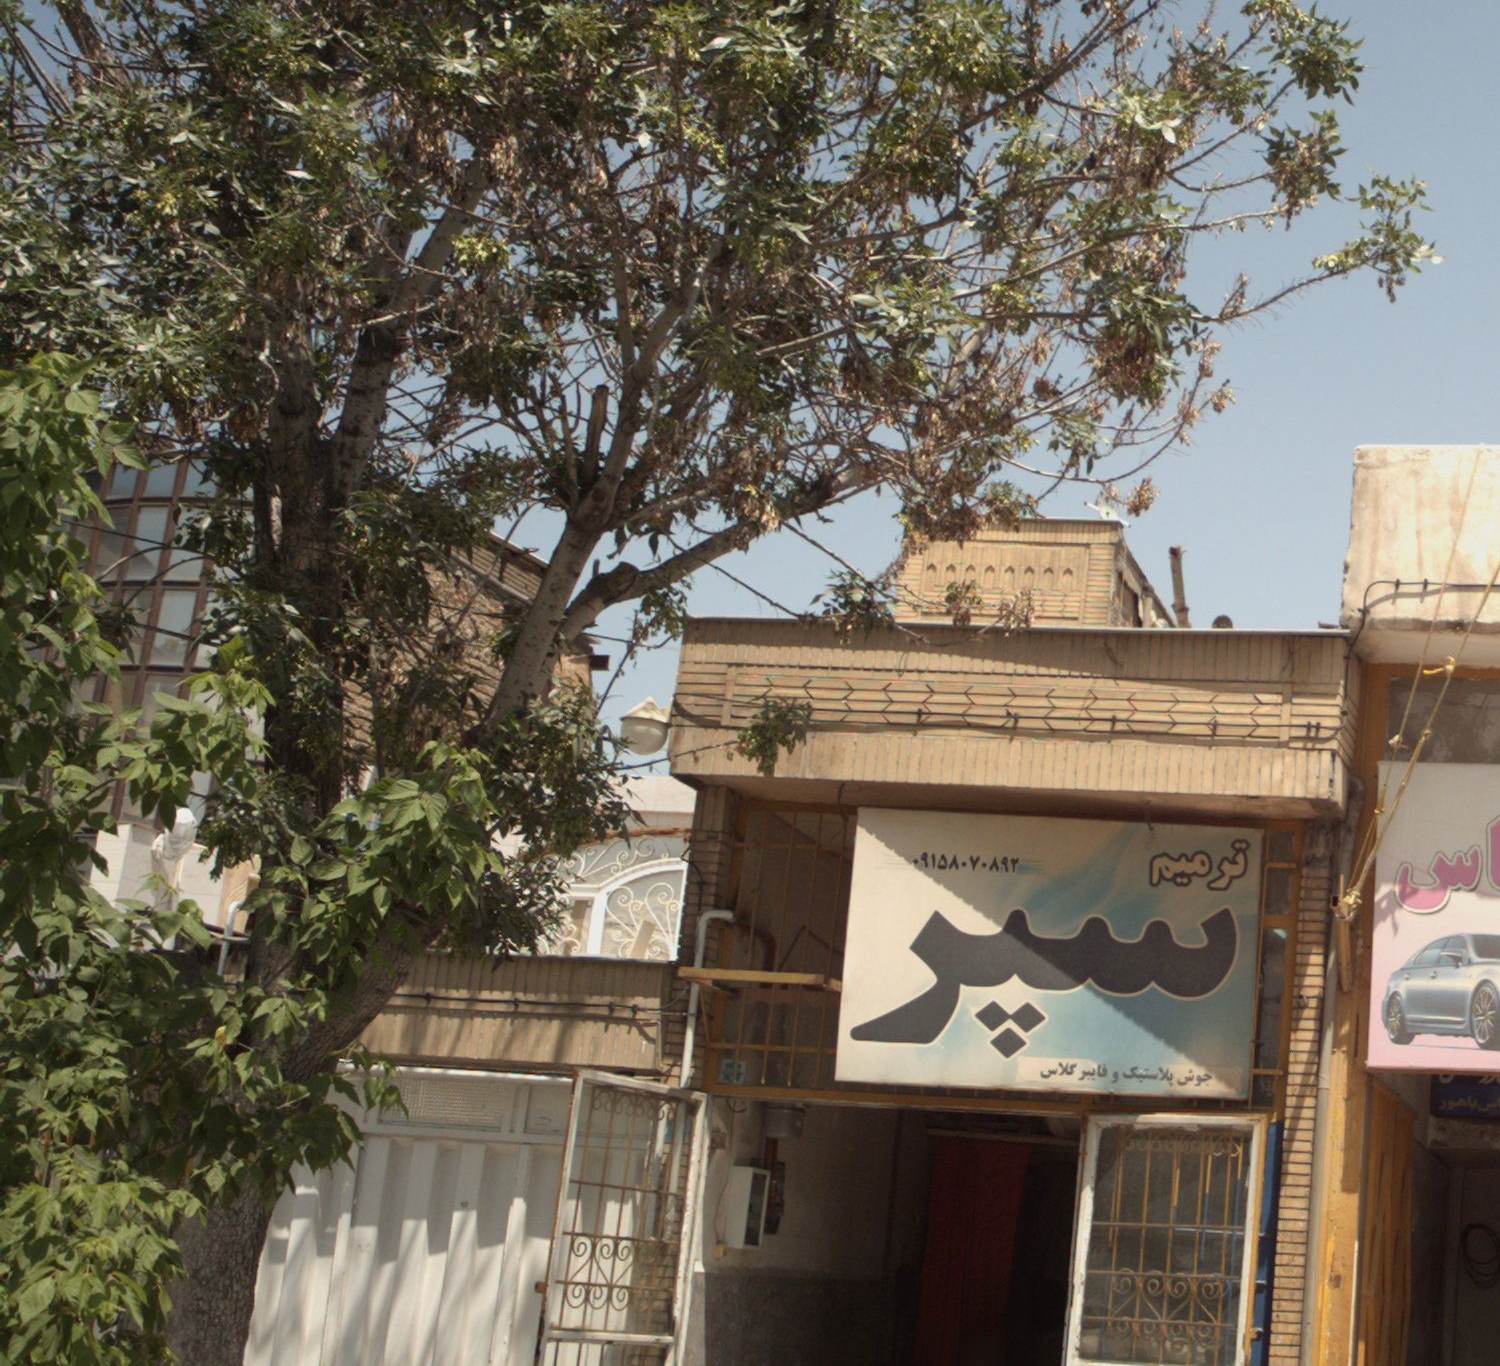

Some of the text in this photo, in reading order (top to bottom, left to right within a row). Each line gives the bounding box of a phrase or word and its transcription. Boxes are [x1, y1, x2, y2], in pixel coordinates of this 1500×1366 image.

[1149, 838, 1251, 891] ترمیم
[850, 906, 1239, 1059] سپر
[1040, 1061, 1078, 1079] گلاس
[1111, 1071, 1120, 1083] و
[1122, 1066, 1174, 1086] پلاستیک
[1176, 1068, 1213, 1087] جوش
